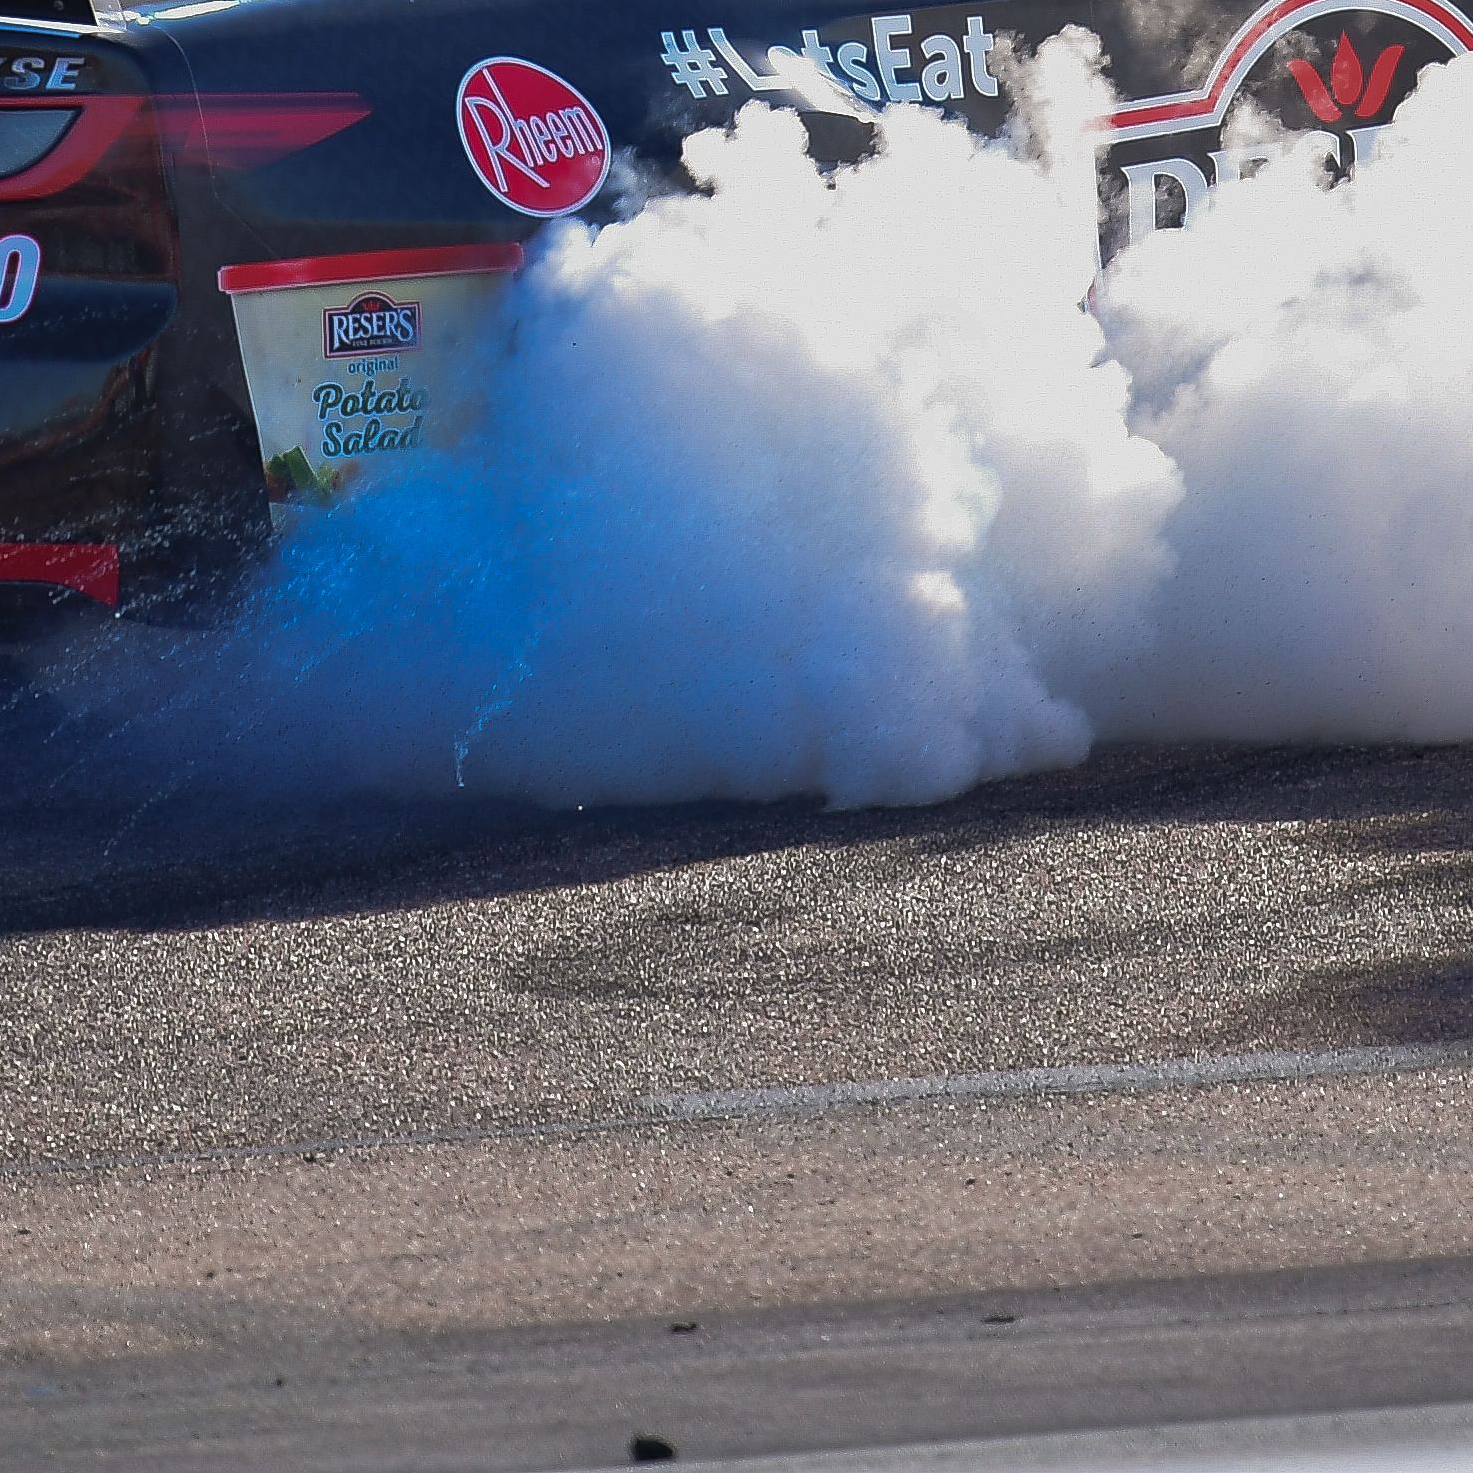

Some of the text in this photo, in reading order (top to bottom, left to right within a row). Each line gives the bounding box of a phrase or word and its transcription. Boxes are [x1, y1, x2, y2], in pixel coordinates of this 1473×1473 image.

[660, 14, 1000, 103] #LtsEat
[464, 67, 604, 193] Rheem
[332, 309, 415, 351] RESER'S
[347, 356, 399, 377] original
[322, 415, 424, 458] Salad
